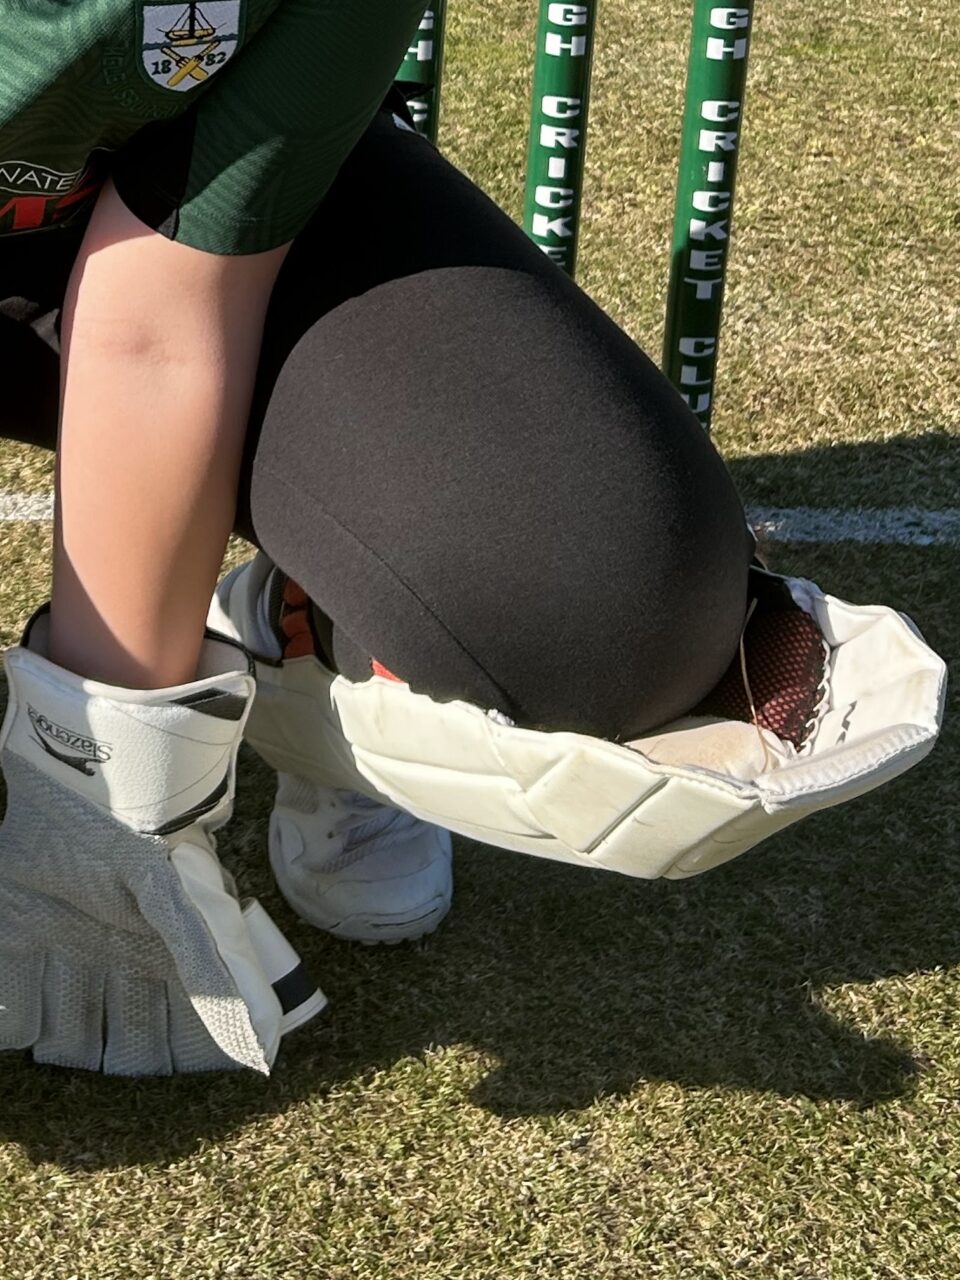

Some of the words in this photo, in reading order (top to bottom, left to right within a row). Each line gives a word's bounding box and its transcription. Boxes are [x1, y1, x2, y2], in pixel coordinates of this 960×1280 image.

[151, 59, 172, 76] 18
[205, 52, 227, 67] 82
[683, 100, 740, 300] CRICKET
[679, 336, 716, 414] CLU
[26, 703, 114, 761] Slazenger
